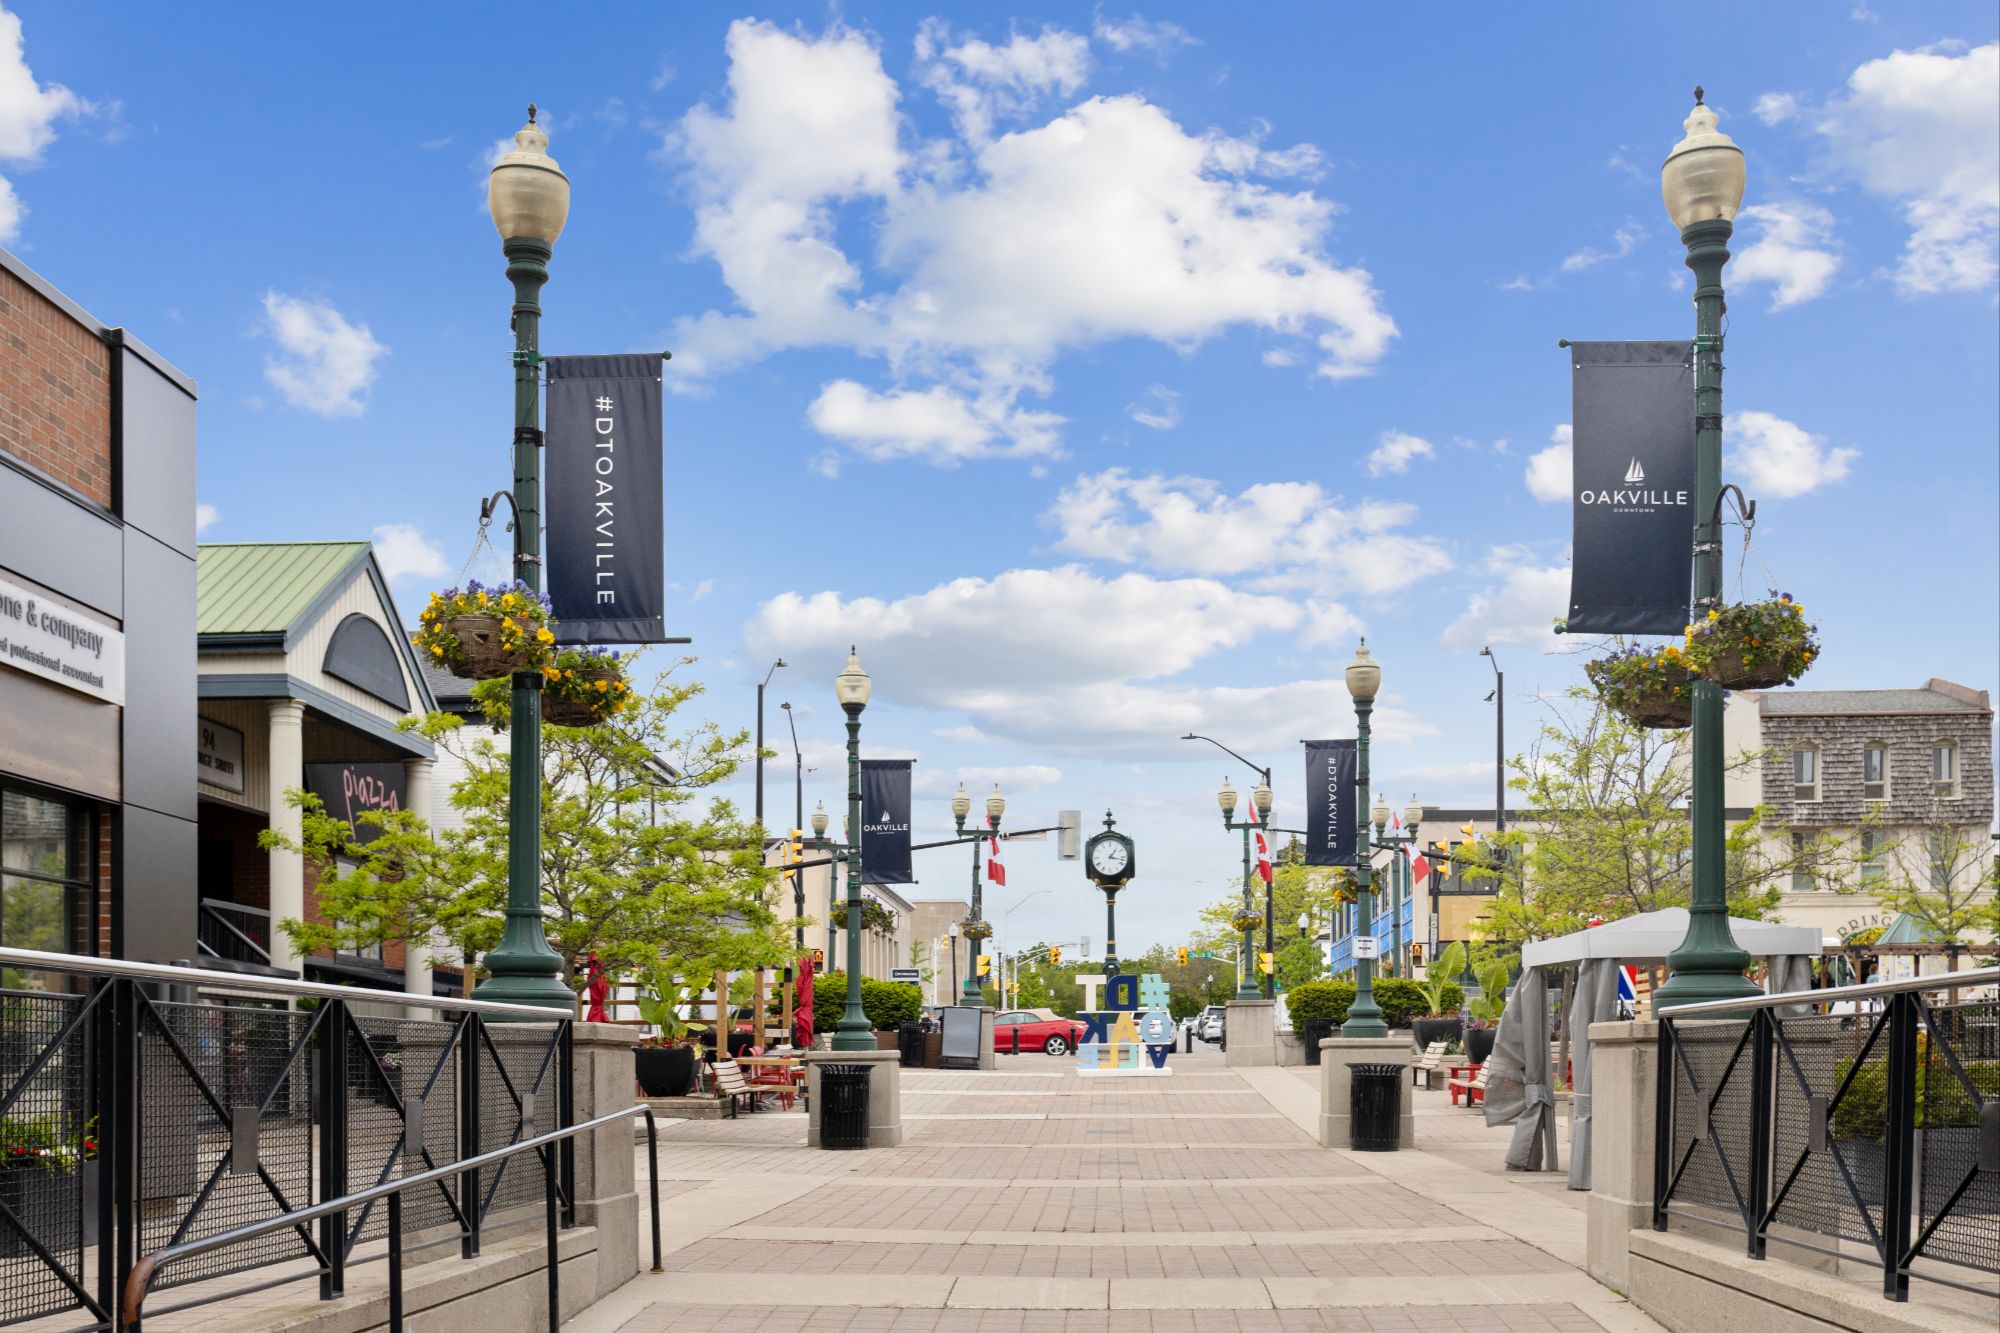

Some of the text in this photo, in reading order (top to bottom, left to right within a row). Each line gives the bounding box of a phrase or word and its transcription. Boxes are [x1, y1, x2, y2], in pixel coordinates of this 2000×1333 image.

[595, 396, 615, 604] #DTOAKVILLE
[1580, 490, 1688, 505] OAKVILLE
[26, 599, 38, 628] &
[41, 612, 104, 660] company
[10, 642, 60, 672] professional
[62, 663, 104, 688] accountant
[203, 727, 216, 751] 94
[1327, 756, 1337, 849] #DTOAKVILLE
[863, 823, 909, 832] OAKVILLE
